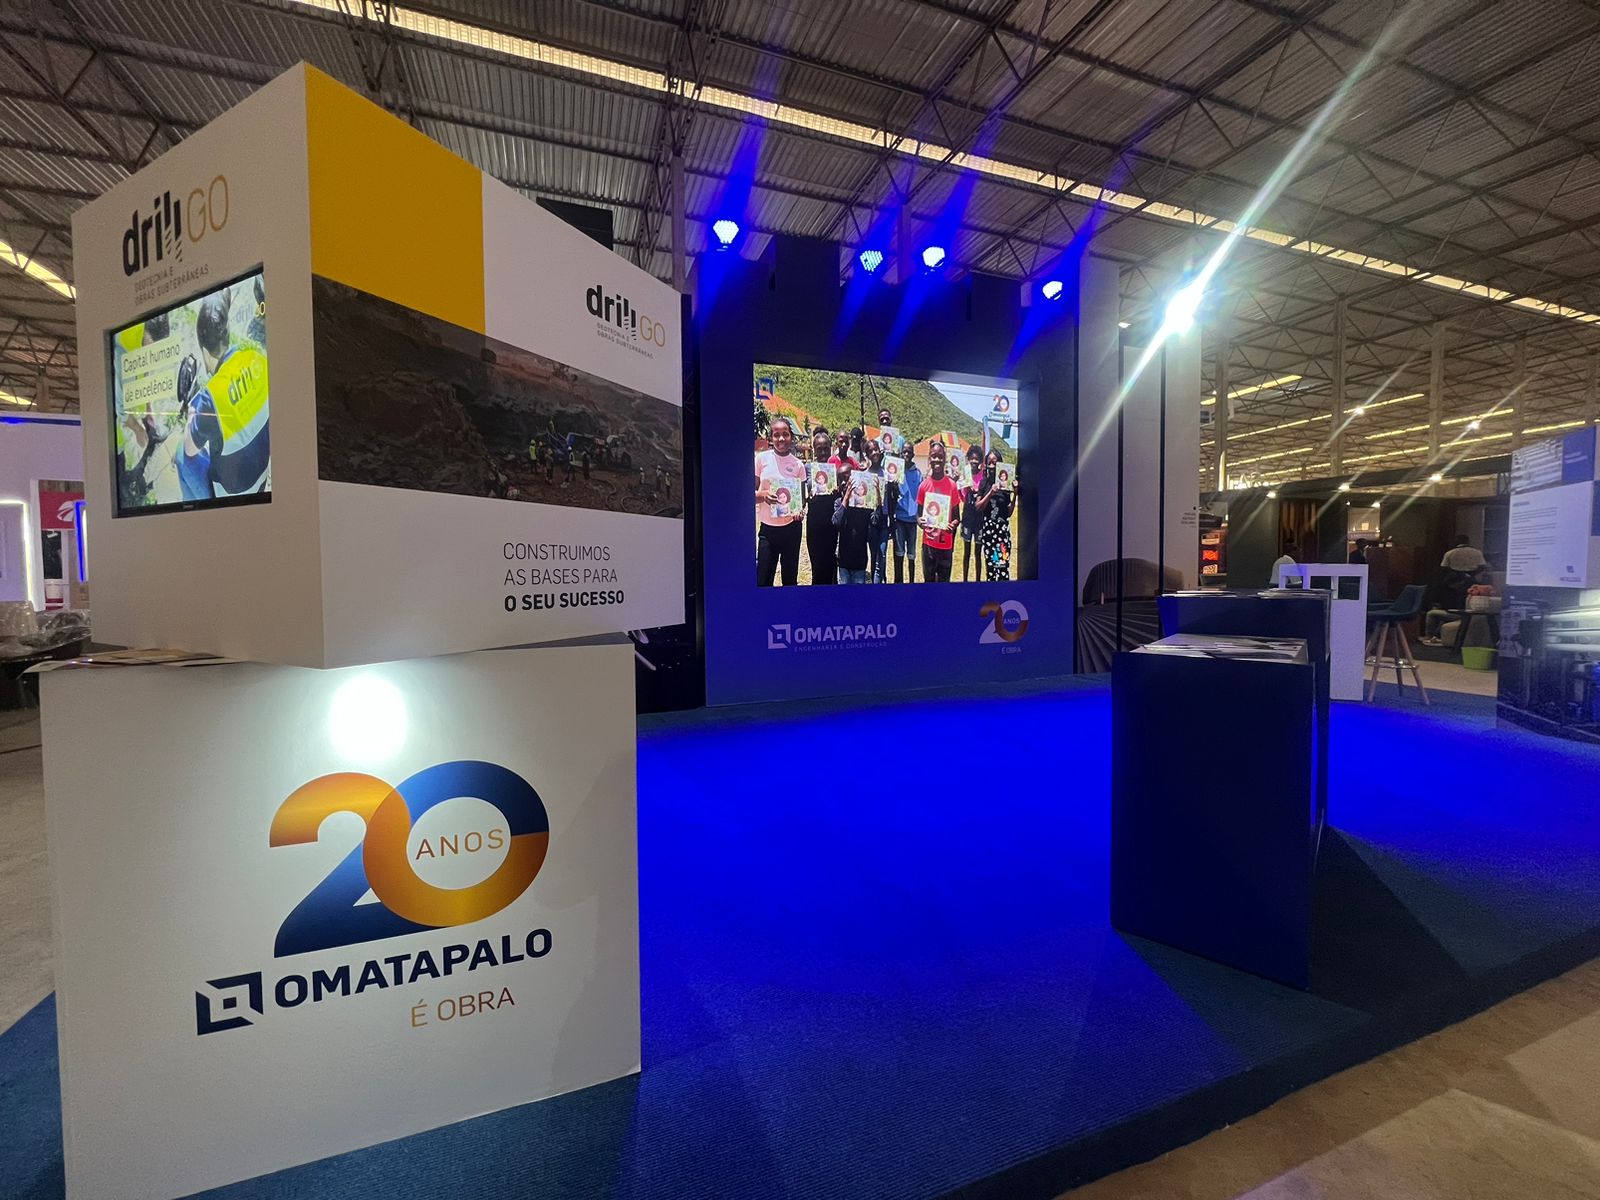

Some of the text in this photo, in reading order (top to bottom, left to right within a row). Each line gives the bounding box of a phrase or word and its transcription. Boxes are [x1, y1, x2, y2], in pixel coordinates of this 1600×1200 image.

[123, 344, 180, 373] Capital humano
[125, 377, 173, 403] de excelência
[503, 542, 611, 561] CONSTRUIMOS
[504, 568, 618, 586] AS BASES PARA
[504, 590, 624, 612] O SEU SUCESSO
[794, 623, 897, 644] OMATAPALO
[979, 600, 1029, 644] 20
[269, 759, 550, 958] 20
[415, 828, 505, 860] ANOS
[274, 928, 553, 1008] OMATAPALO
[411, 986, 515, 1028] É OBRA
